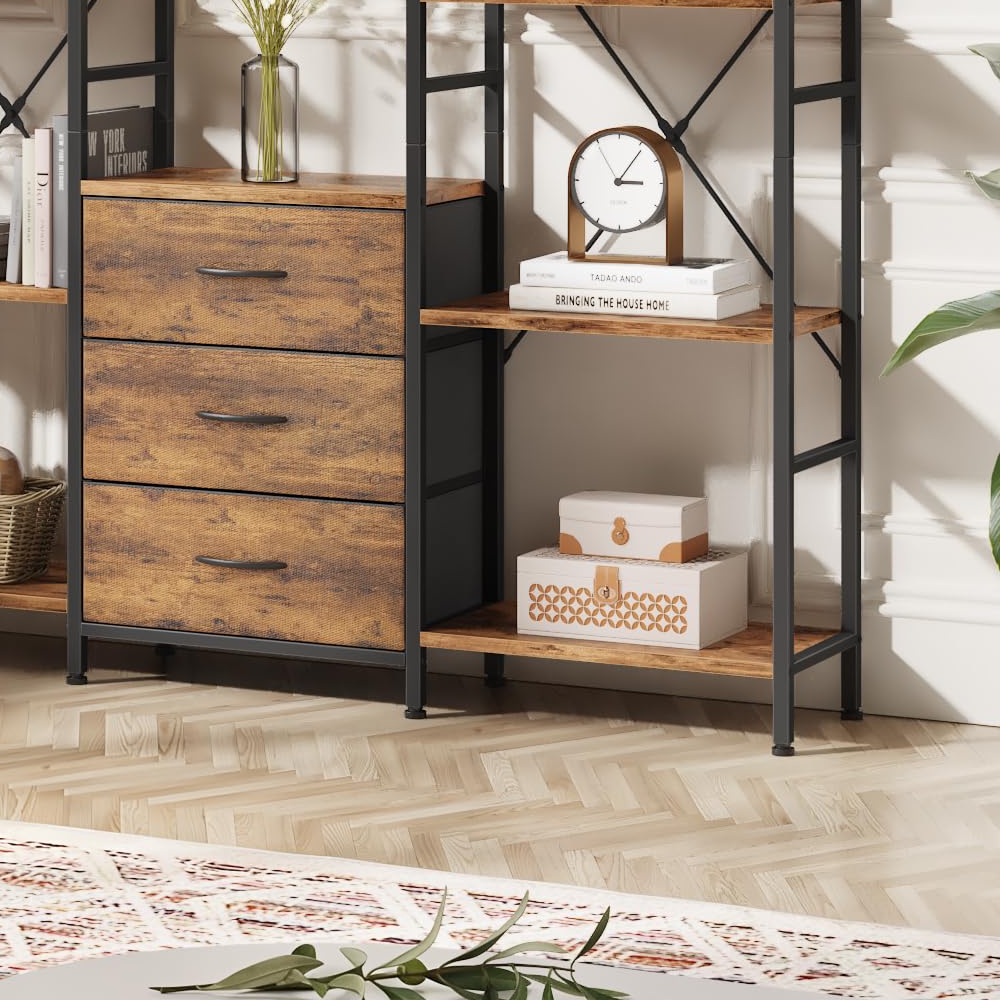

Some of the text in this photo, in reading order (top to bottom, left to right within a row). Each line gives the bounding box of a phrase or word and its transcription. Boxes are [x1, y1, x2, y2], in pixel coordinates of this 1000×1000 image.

[103, 128, 125, 155] YORK
[591, 273, 643, 284] TADAO ANDO
[555, 294, 670, 311] BRINGING THE HOUSE HOME
